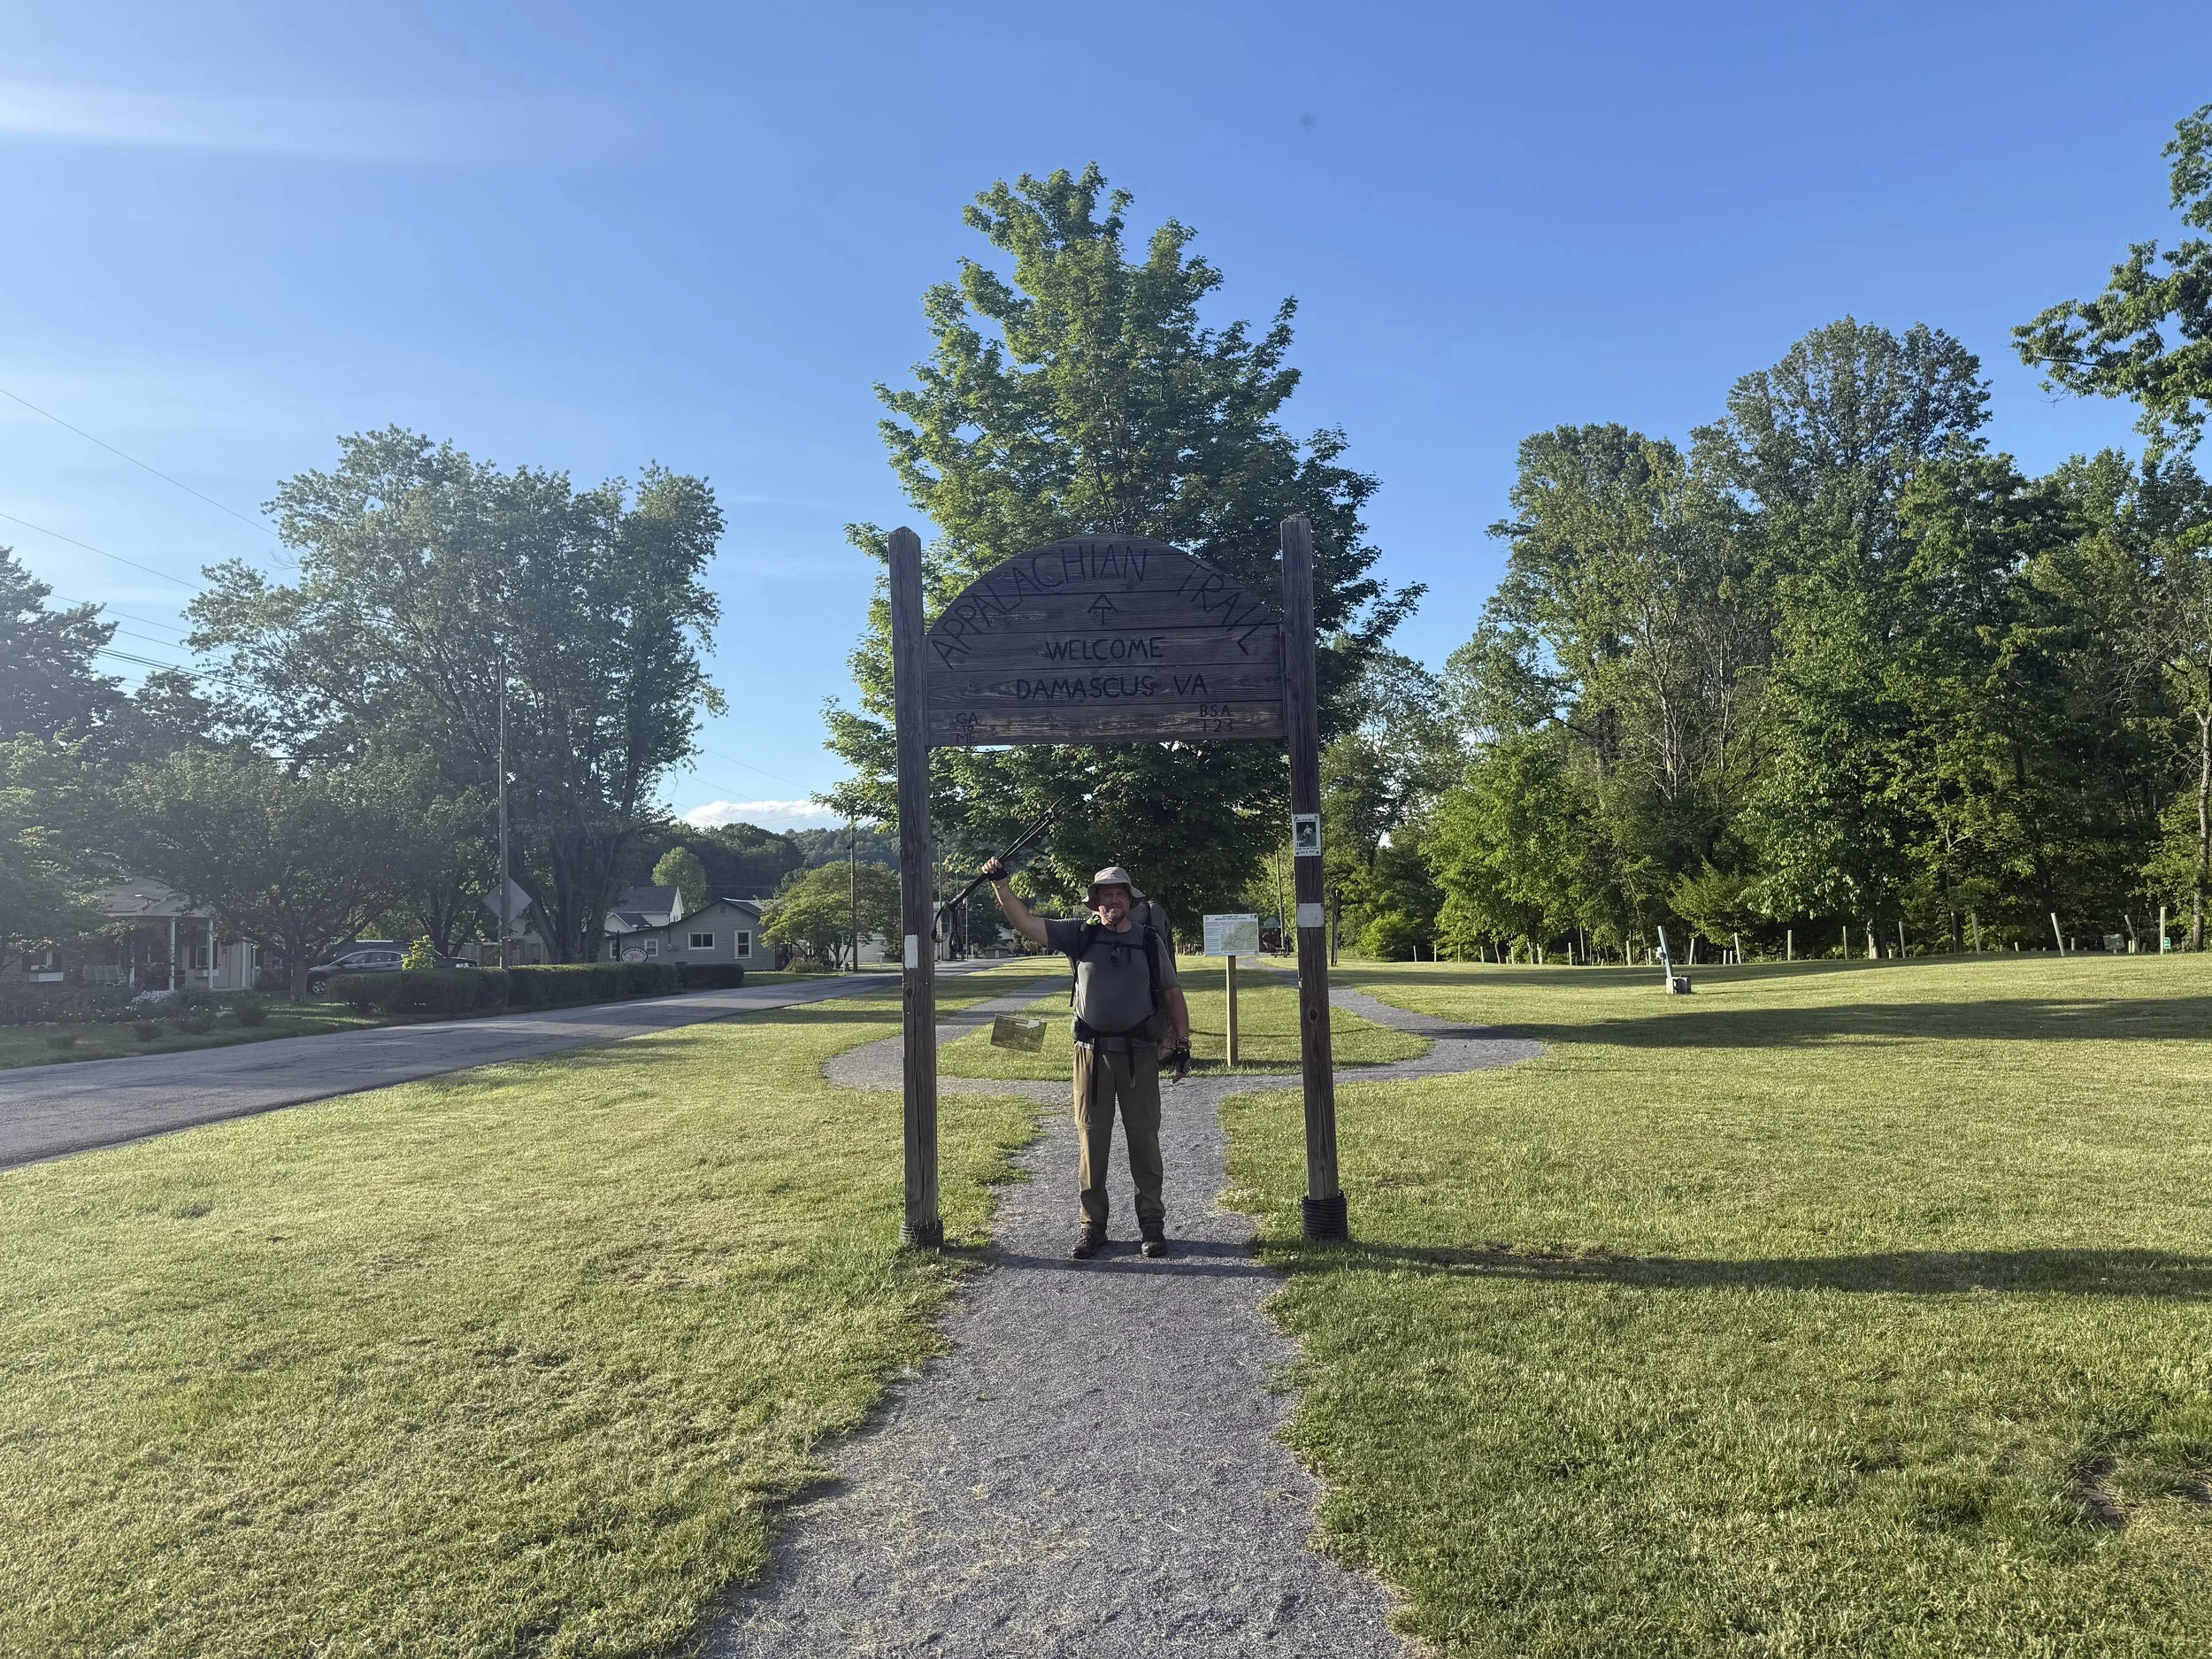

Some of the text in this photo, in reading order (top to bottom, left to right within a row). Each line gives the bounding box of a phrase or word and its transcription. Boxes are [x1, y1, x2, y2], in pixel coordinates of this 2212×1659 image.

[930, 544, 1267, 671] APPALACHIAN TRAIL
[1045, 636, 1165, 661] WELCOME
[1017, 673, 1209, 700] DAMASCUS VA
[956, 712, 979, 725] GA
[1200, 704, 1231, 718] BSA
